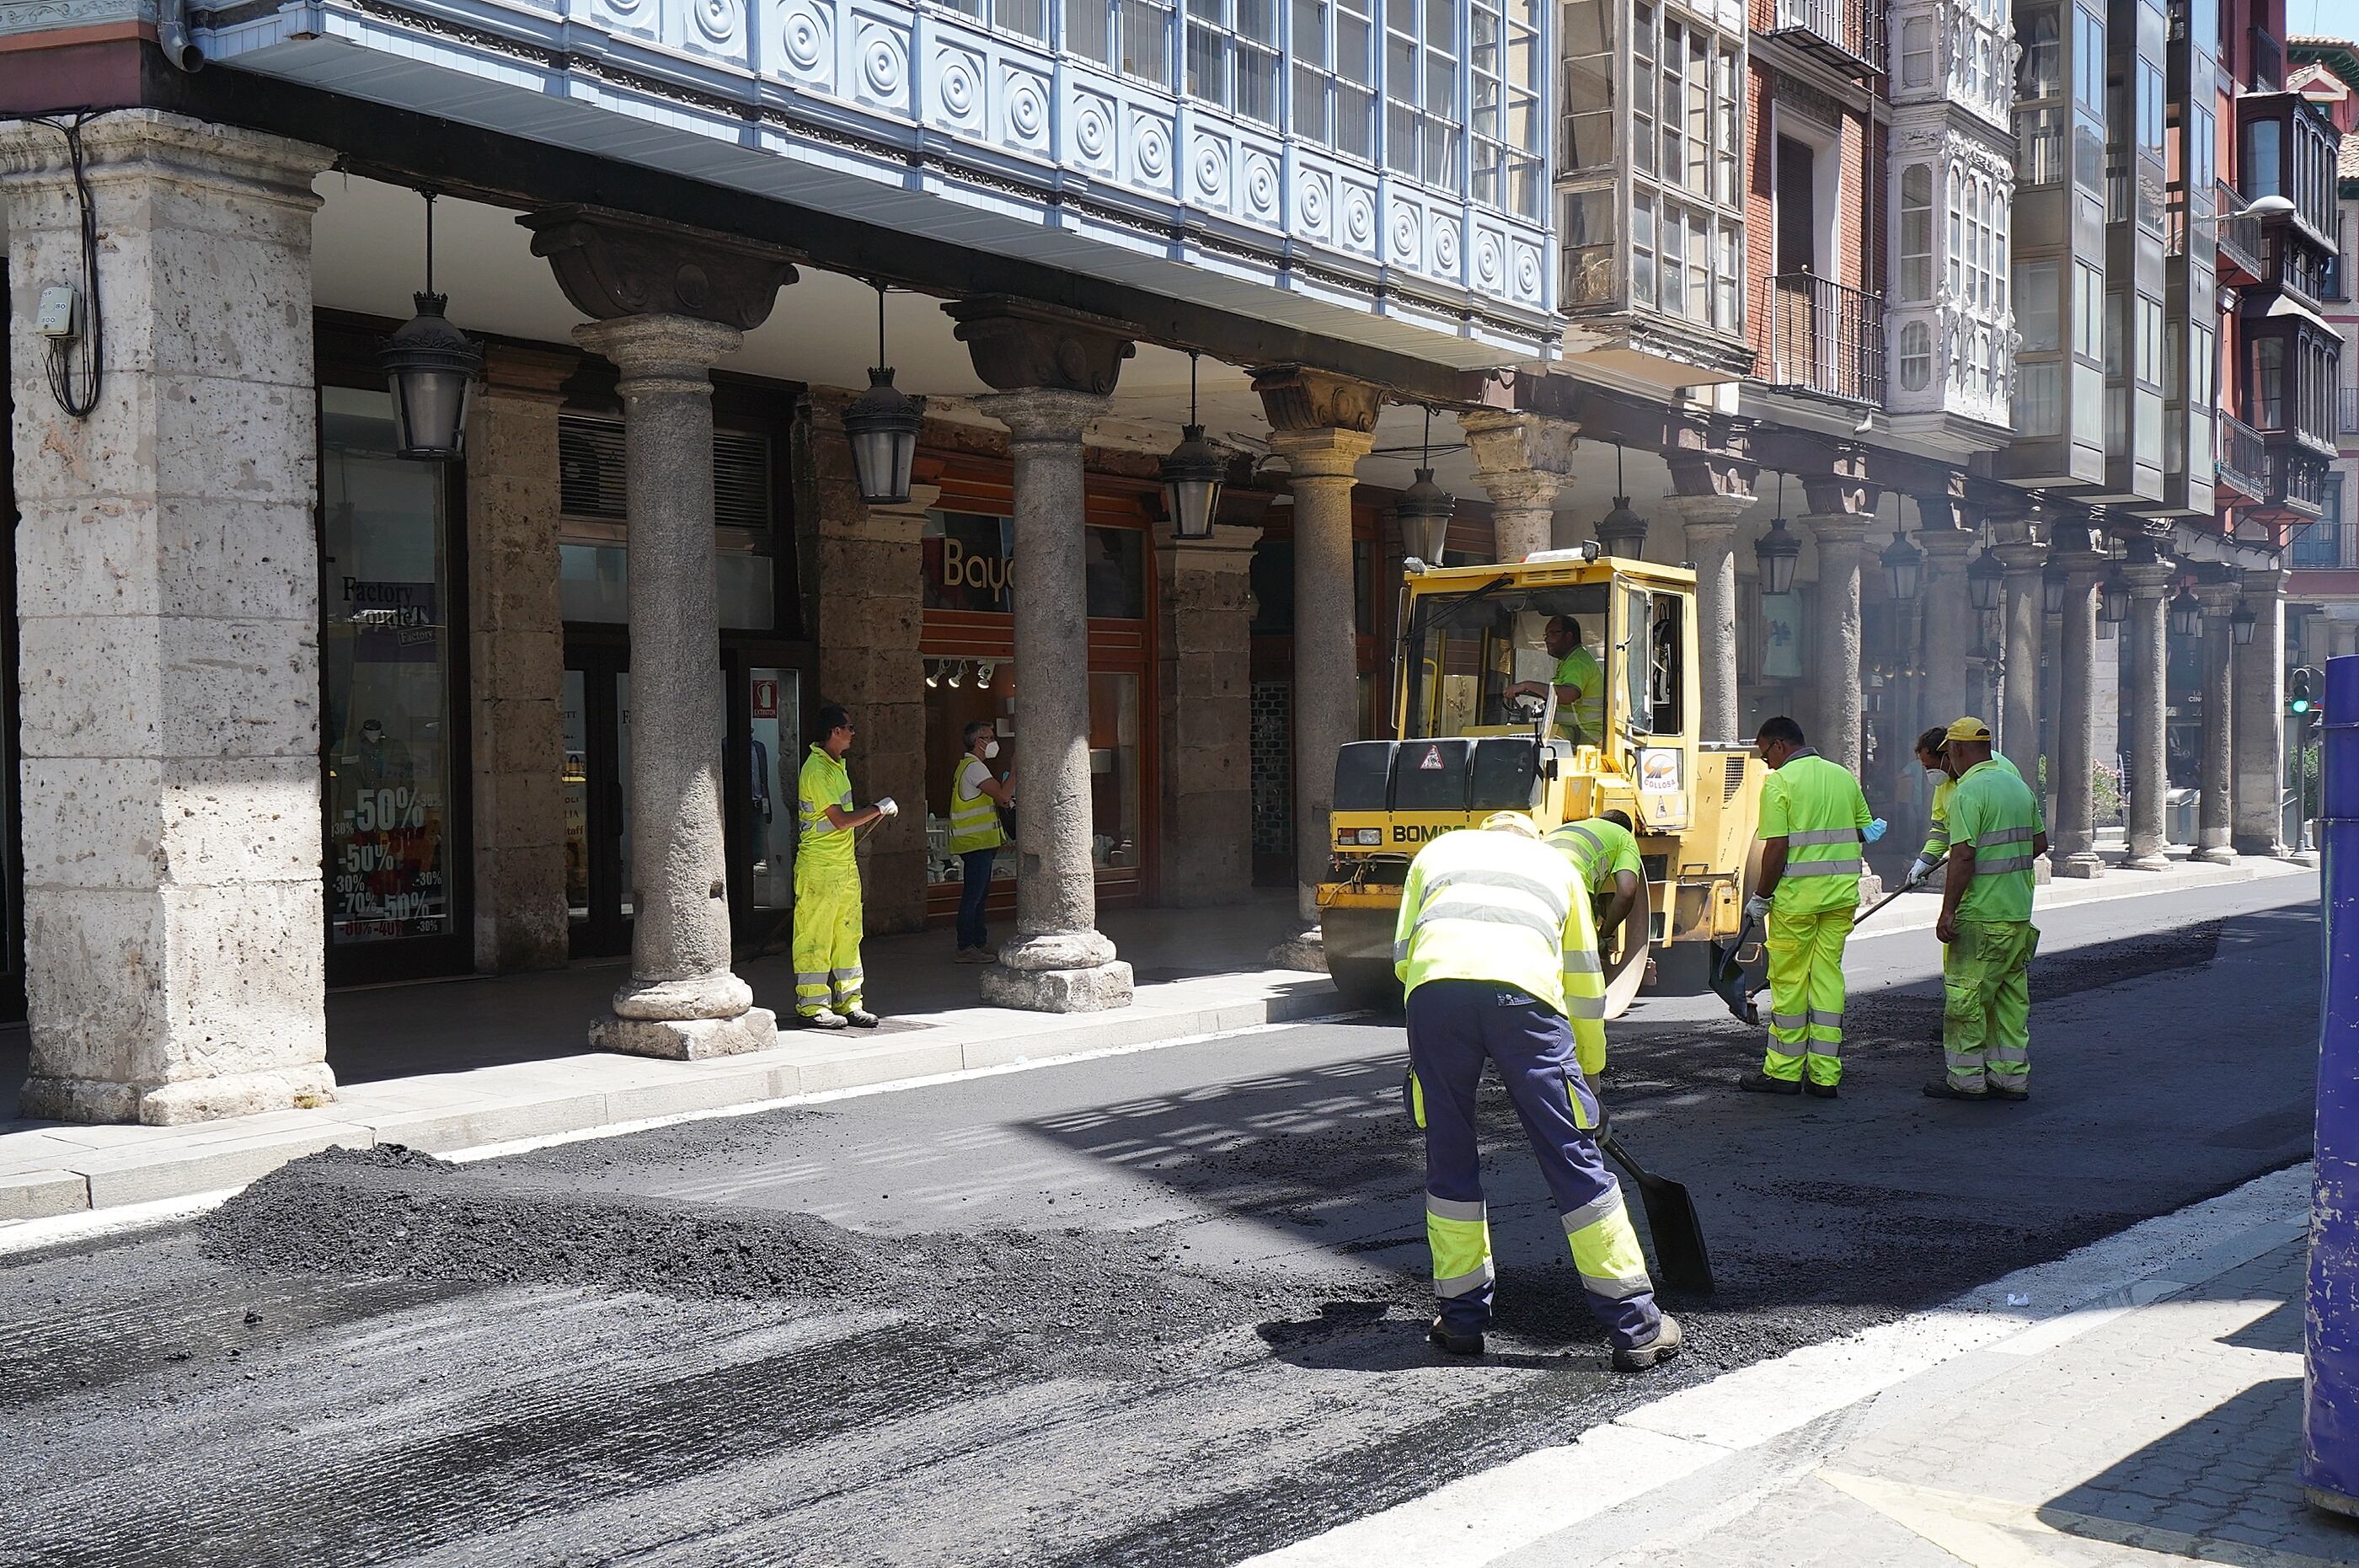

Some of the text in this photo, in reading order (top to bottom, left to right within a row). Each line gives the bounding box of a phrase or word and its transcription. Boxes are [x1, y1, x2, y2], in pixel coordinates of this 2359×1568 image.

[343, 576, 413, 607] Factory
[1644, 779, 1677, 789] COLLOSA
[343, 782, 425, 831] -50%
[1393, 826, 1466, 842] BOM
[338, 842, 394, 872] -50%
[332, 873, 366, 893] -30%
[415, 870, 443, 886] -30%
[339, 891, 430, 919] -70% -50%
[416, 920, 438, 932] -30%
